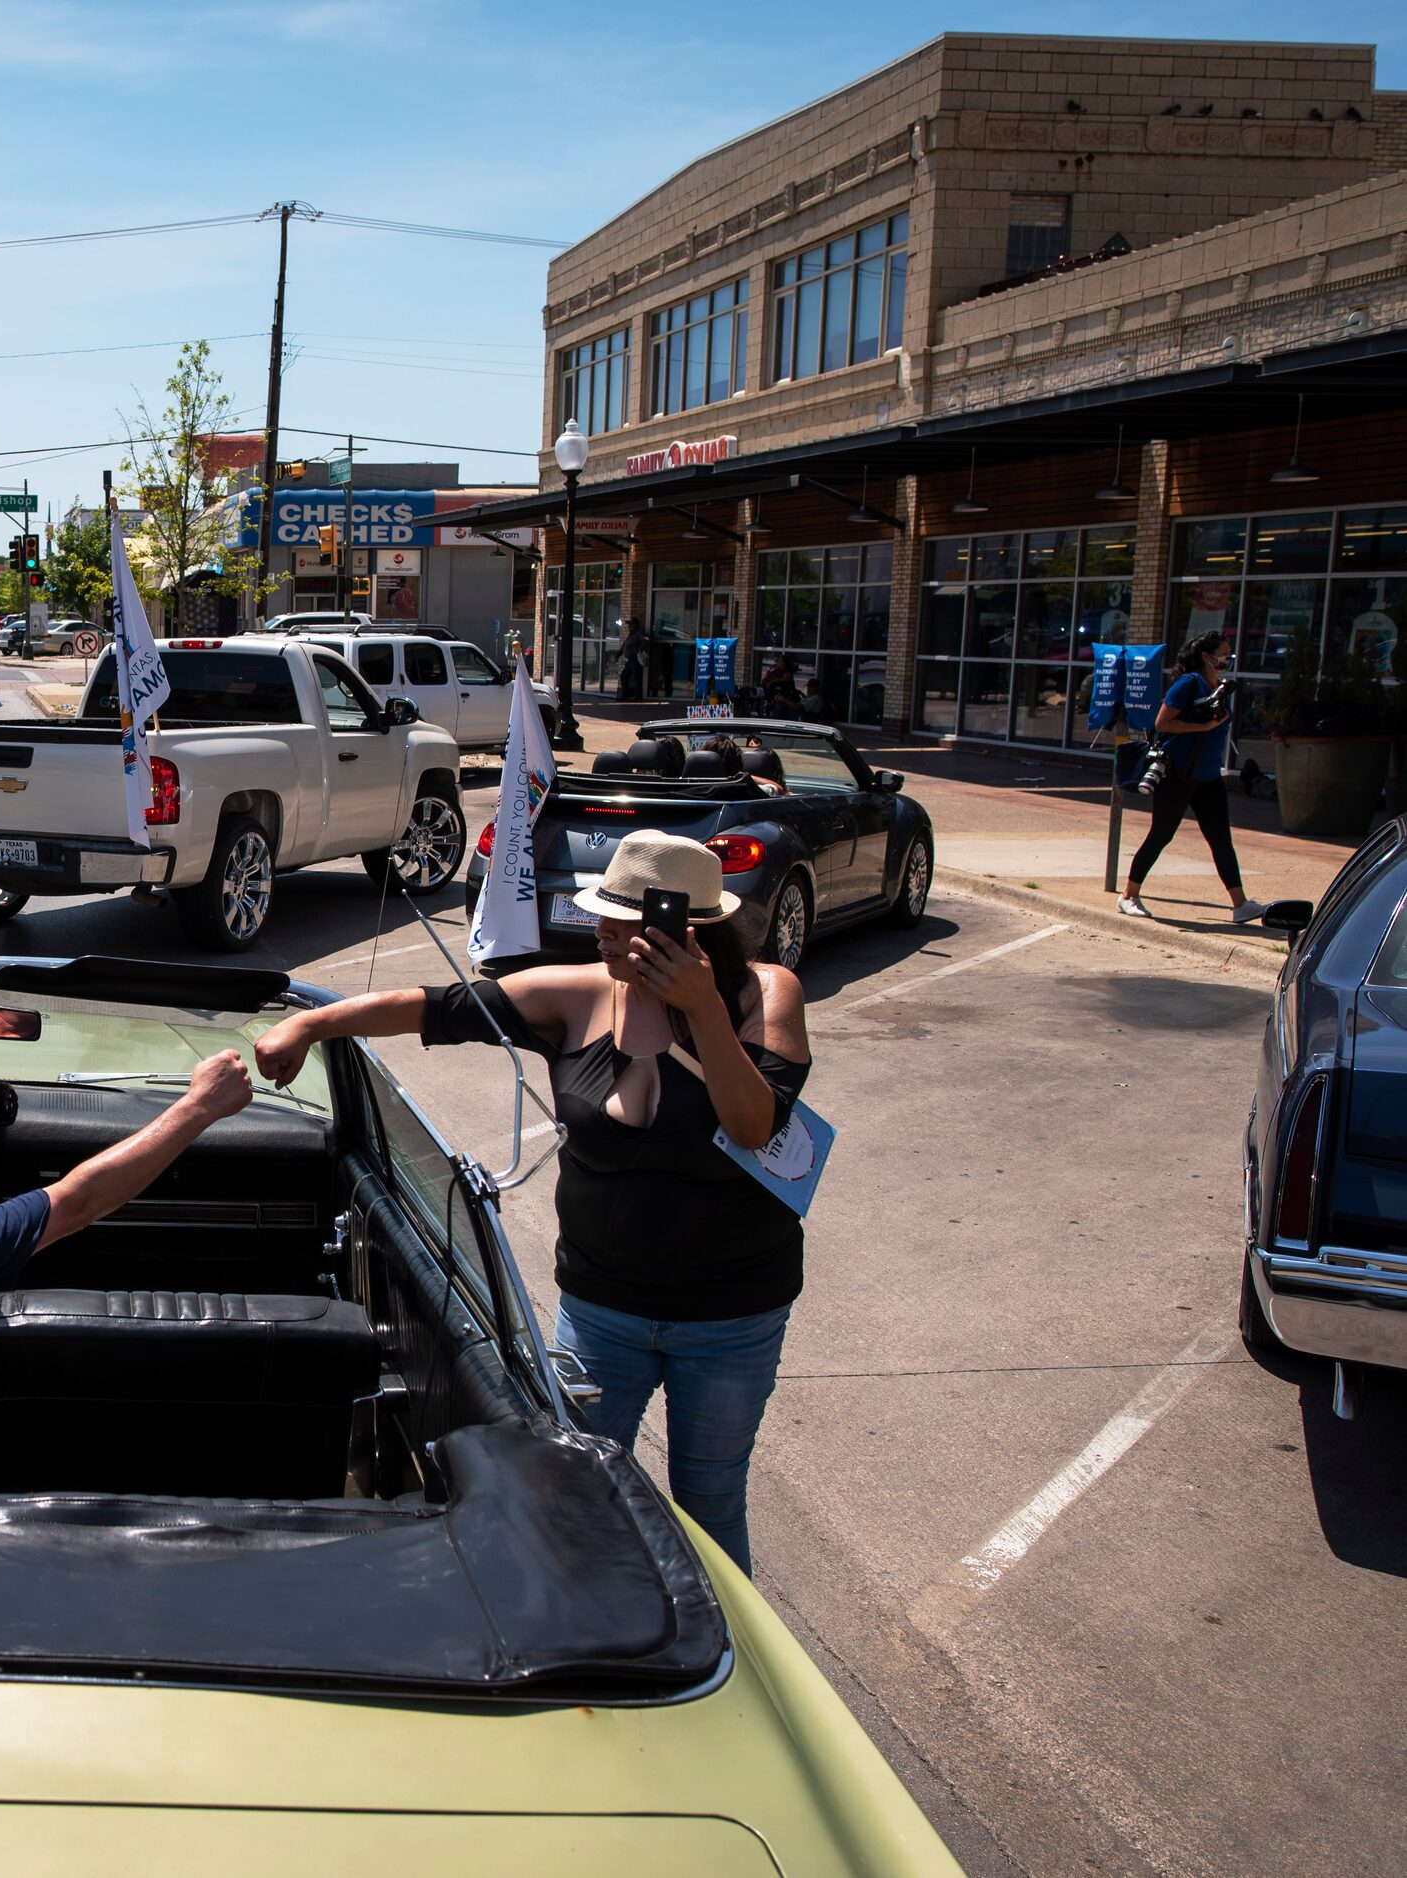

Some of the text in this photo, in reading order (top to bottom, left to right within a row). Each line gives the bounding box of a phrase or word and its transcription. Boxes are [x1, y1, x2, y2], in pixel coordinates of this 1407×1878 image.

[575, 521, 599, 529] AMILY
[513, 789, 527, 820] YOU
[504, 825, 523, 877] COUNT,
[768, 1137, 783, 1159] ALL
